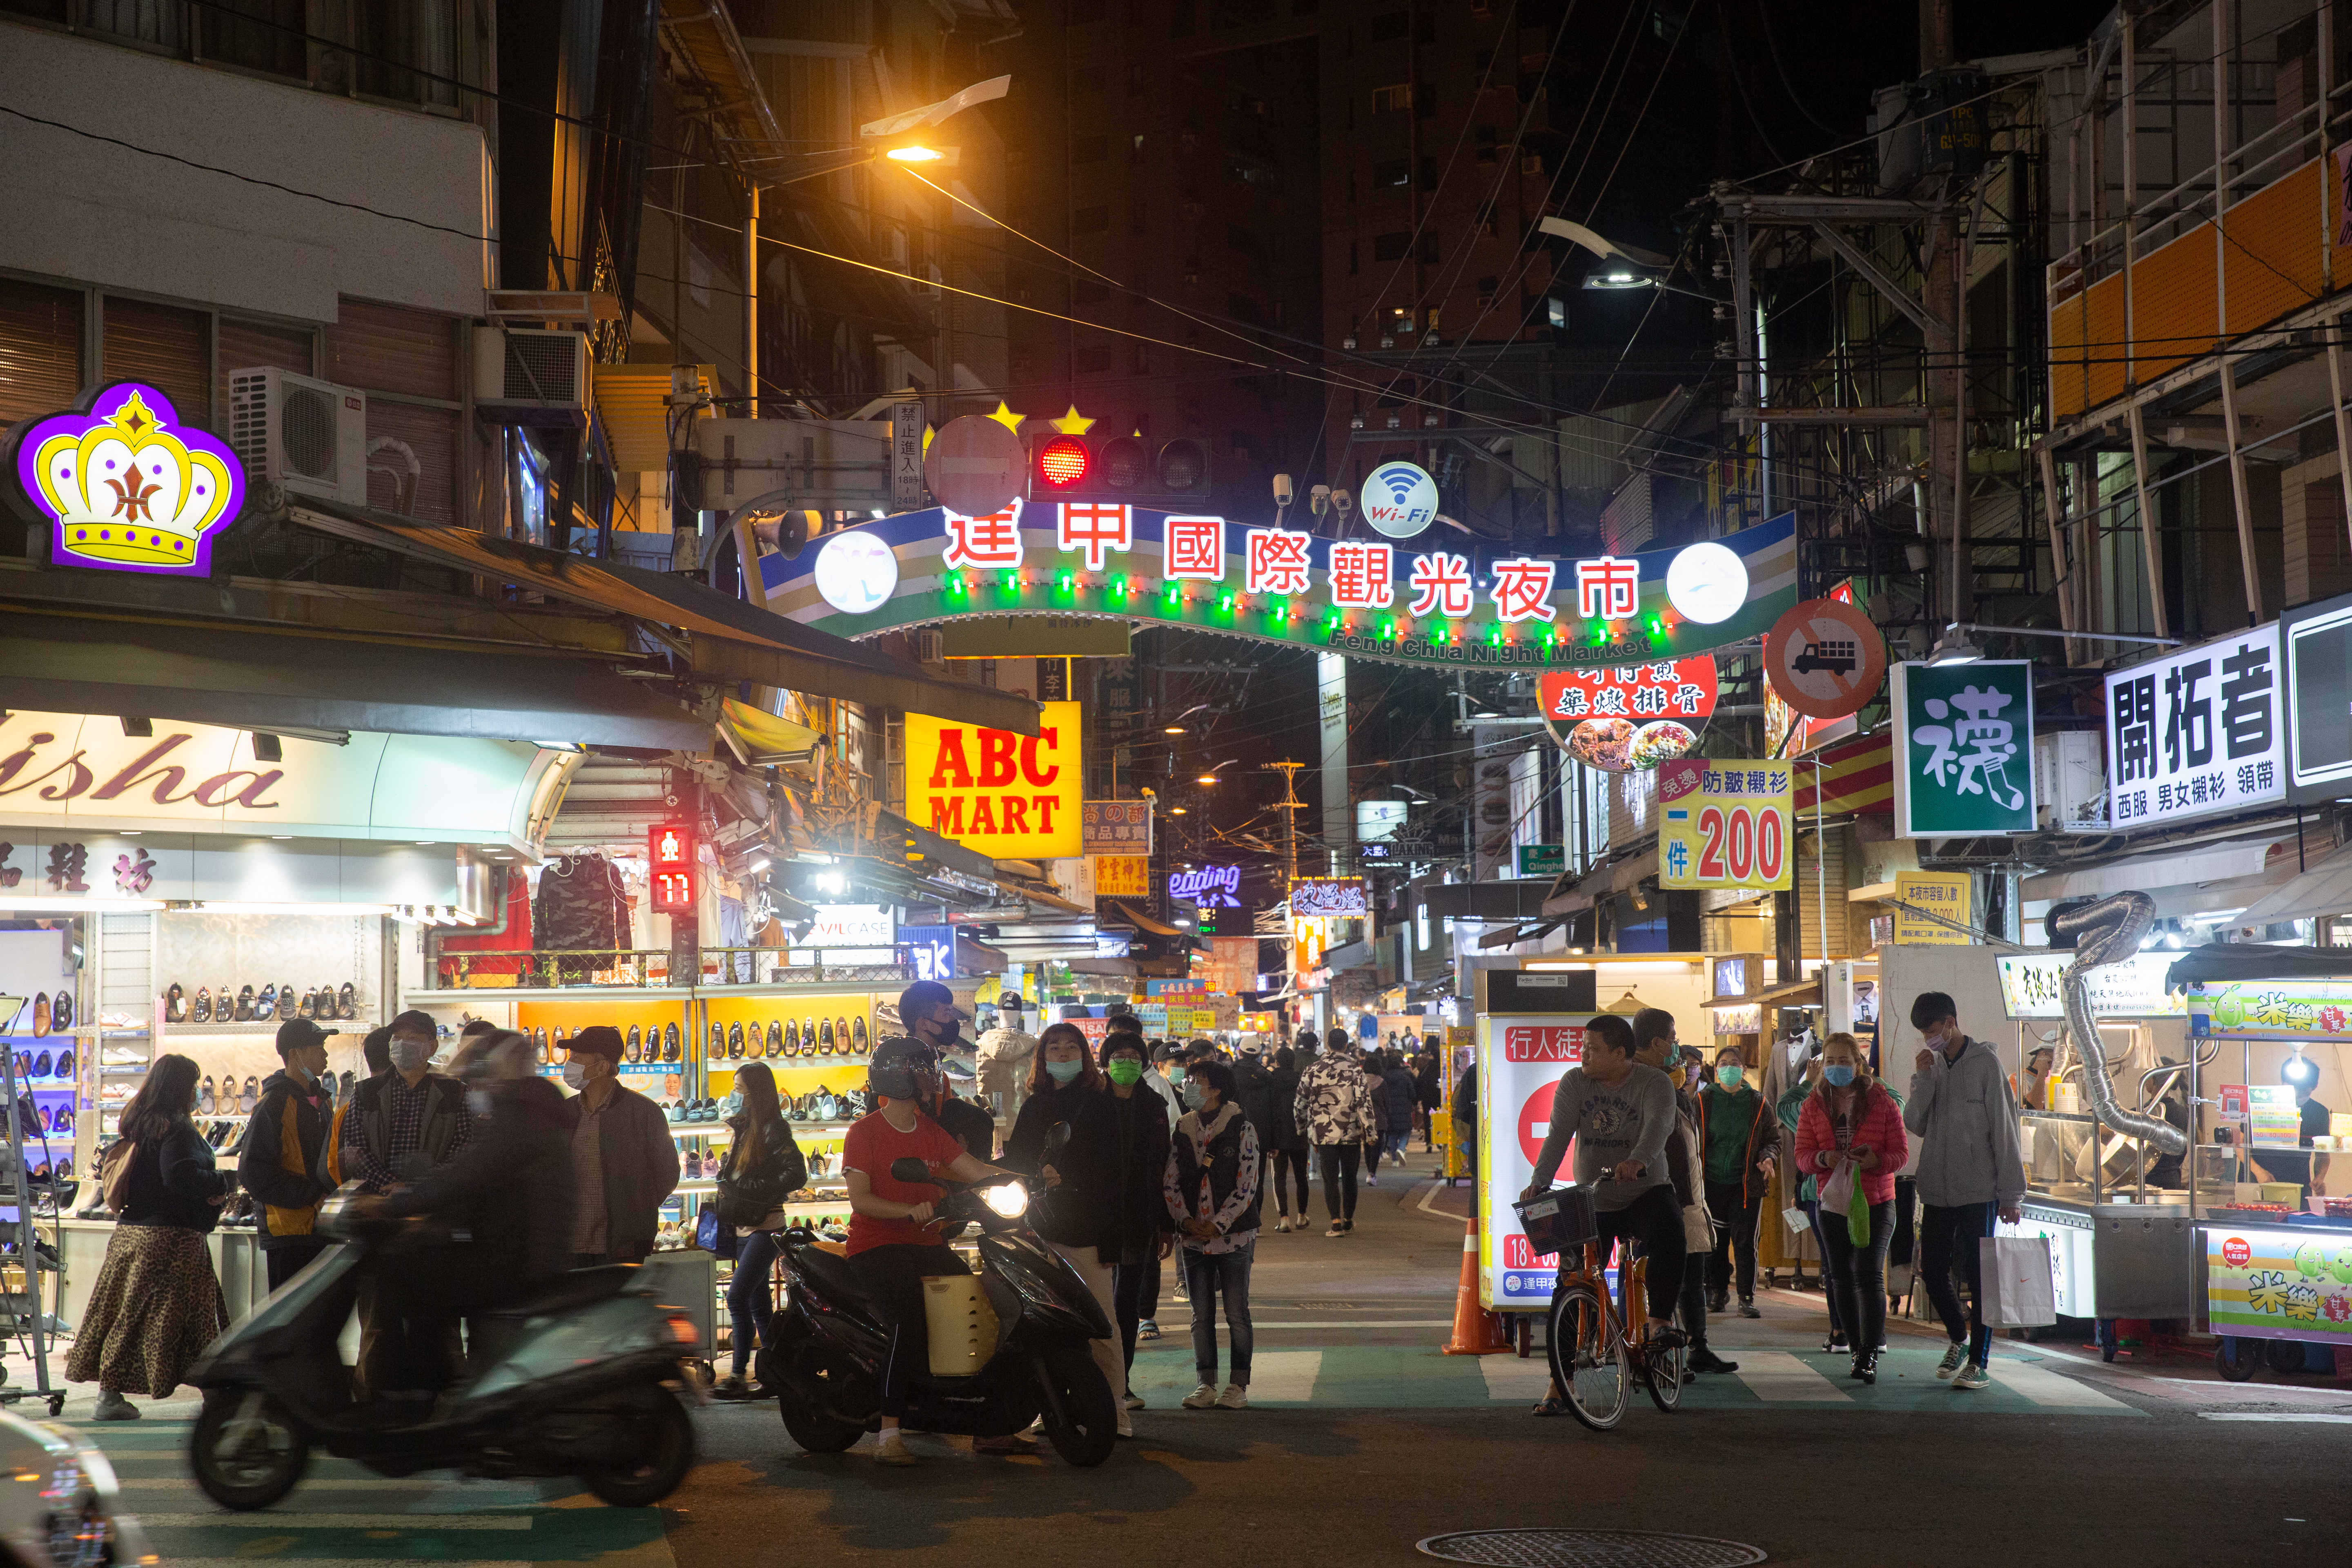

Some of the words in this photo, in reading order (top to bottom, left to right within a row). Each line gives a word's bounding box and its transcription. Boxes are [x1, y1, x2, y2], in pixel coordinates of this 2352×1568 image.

[900, 407, 916, 473] 禁止進入
[898, 475, 919, 486] 18時
[897, 496, 918, 506] 24時
[1372, 506, 1429, 523] Wi-Fi
[1329, 629, 1397, 656] Feng
[1401, 639, 1464, 660] Chia
[1470, 643, 1546, 663] Night
[1550, 636, 1653, 662] Market
[1554, 684, 1705, 716] 藥燉排骨
[2113, 643, 2274, 786] 開拓者
[0, 713, 284, 808] isha
[929, 727, 1060, 788] ABC
[1661, 768, 1699, 798] 免燙
[1701, 770, 1788, 795] 防皺襯衫
[2118, 790, 2147, 820] 西服
[2158, 771, 2225, 813] 男女襯衫
[2237, 760, 2274, 795] 領帶
[929, 795, 1060, 835] MART
[1083, 804, 1145, 824] 尚の都
[1667, 808, 1688, 879] 一件
[1697, 805, 1784, 882] 200
[659, 874, 688, 902] 77
[1909, 885, 1957, 901] 本夜市容留人數
[2256, 991, 2313, 1031] 米樂
[2323, 1009, 2341, 1031] 甘草
[2248, 1271, 2319, 1323] 米樂
